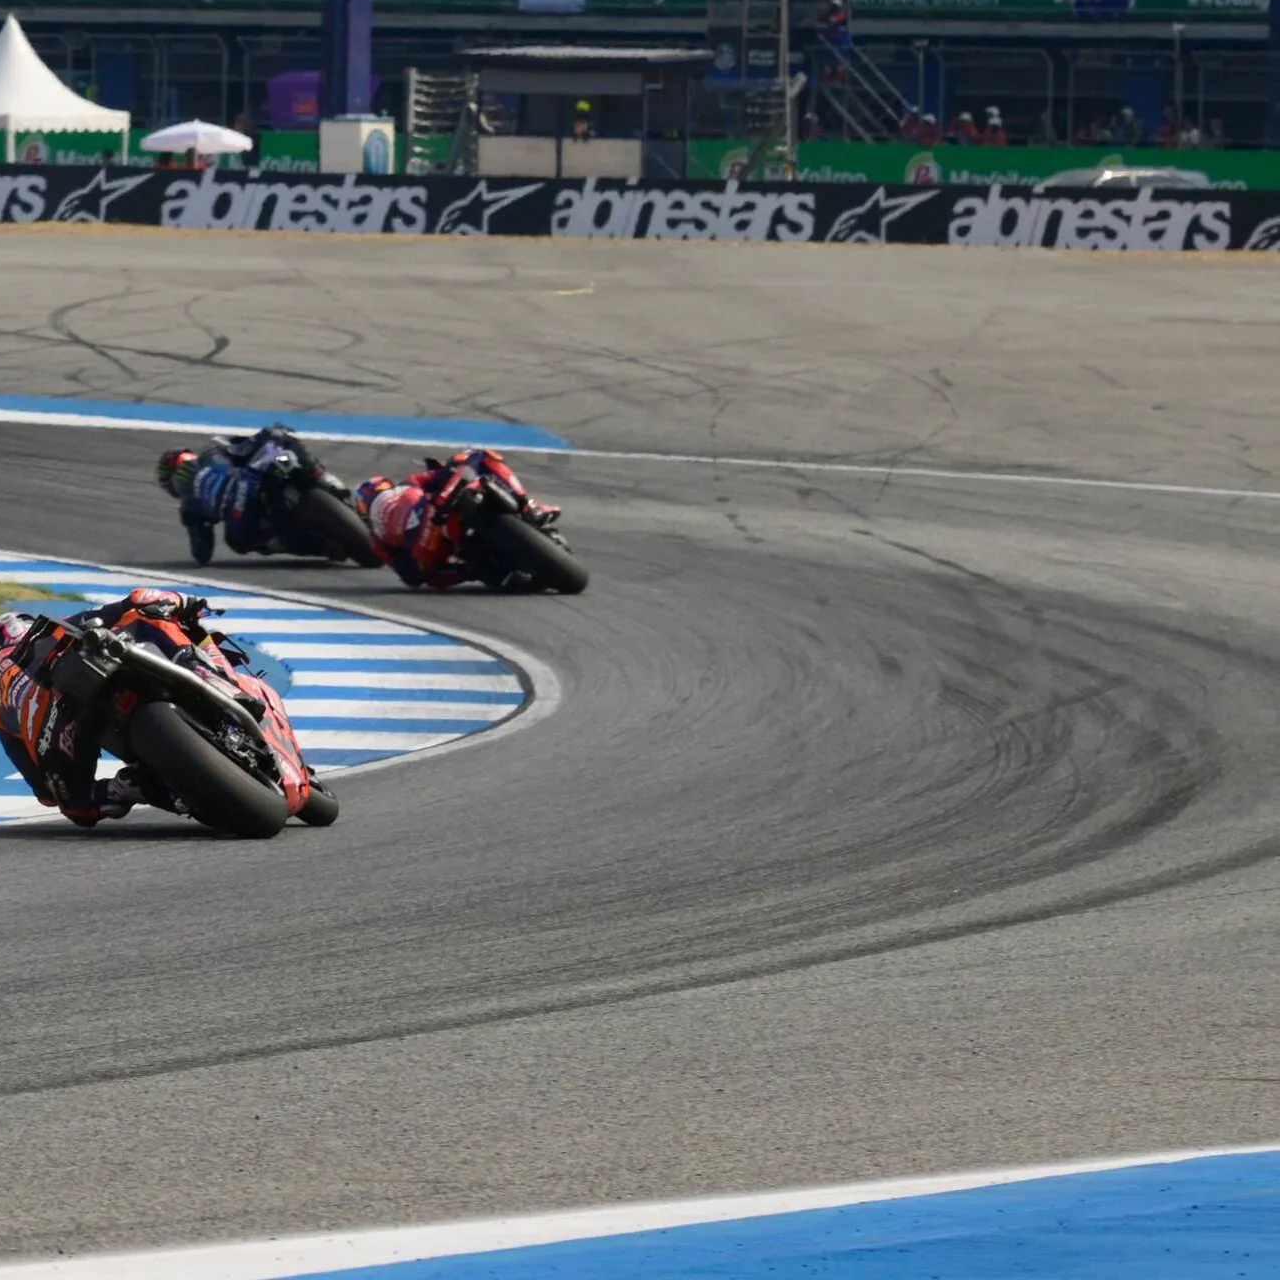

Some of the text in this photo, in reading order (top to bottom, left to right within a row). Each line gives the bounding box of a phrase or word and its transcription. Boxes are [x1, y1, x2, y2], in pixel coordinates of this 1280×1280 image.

[160, 166, 428, 233] alpinestars
[550, 176, 816, 243] alpinestars
[947, 185, 1231, 250] alpinestars
